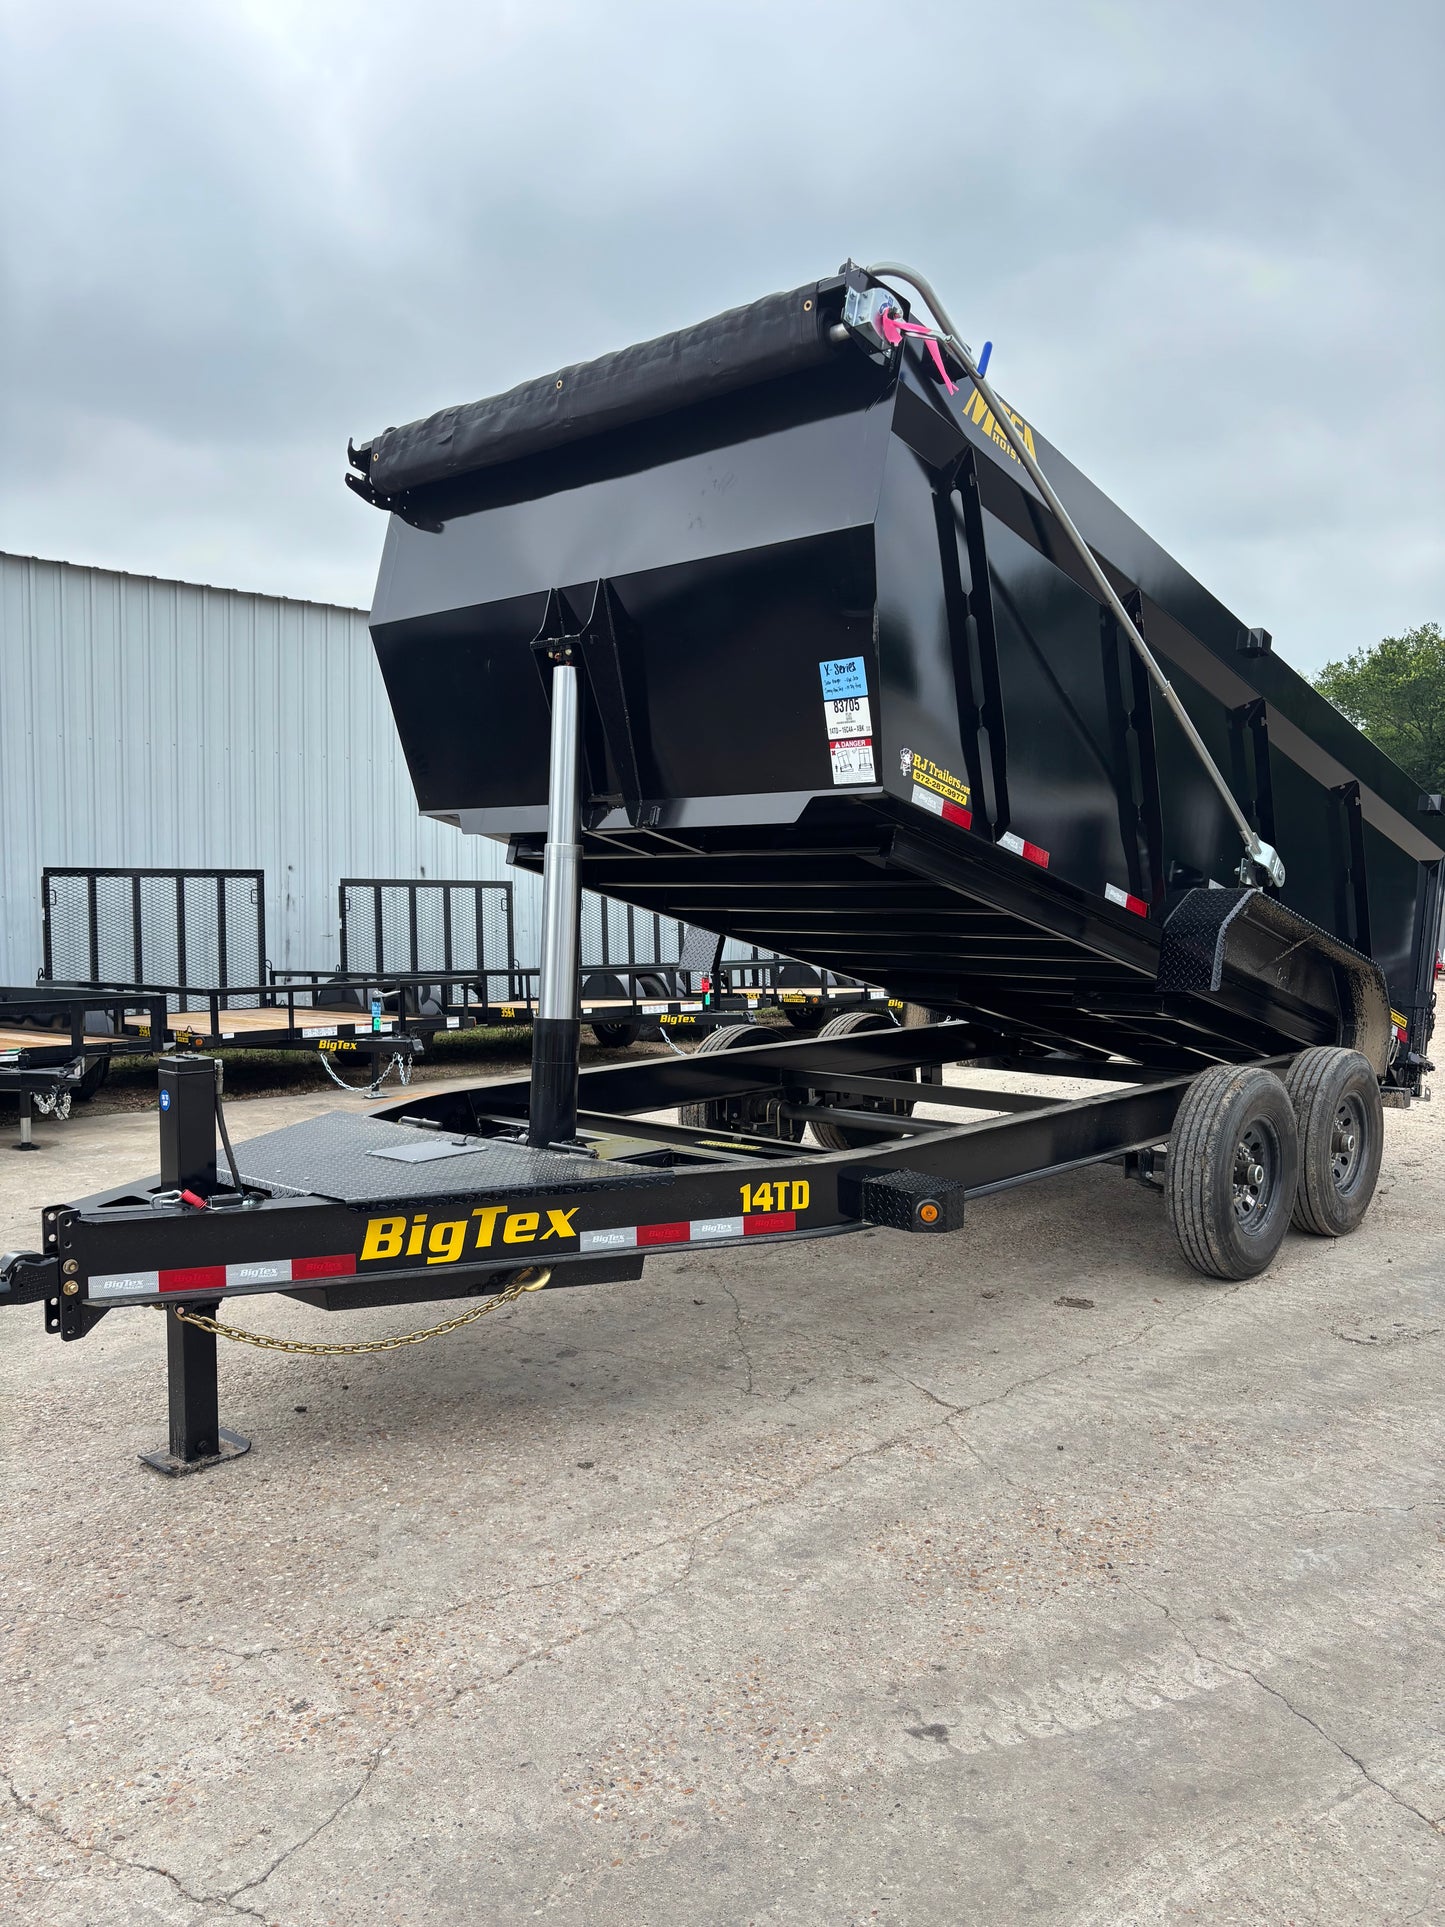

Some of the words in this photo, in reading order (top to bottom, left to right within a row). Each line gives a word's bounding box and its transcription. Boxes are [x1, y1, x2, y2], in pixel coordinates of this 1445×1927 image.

[833, 698, 860, 713] 83705
[841, 740, 866, 748] DANGER
[912, 753, 929, 771] RJ
[915, 772, 965, 802] 972-287-9977
[659, 1014, 697, 1025] BigTex
[318, 1040, 358, 1052] BigTex
[740, 1180, 810, 1213] 14TD
[702, 1224, 733, 1233] BigTex
[359, 1205, 580, 1265] BigTex
[592, 1234, 625, 1244] BigTex
[240, 1267, 278, 1278] BigTex
[104, 1279, 144, 1289] BigTex
